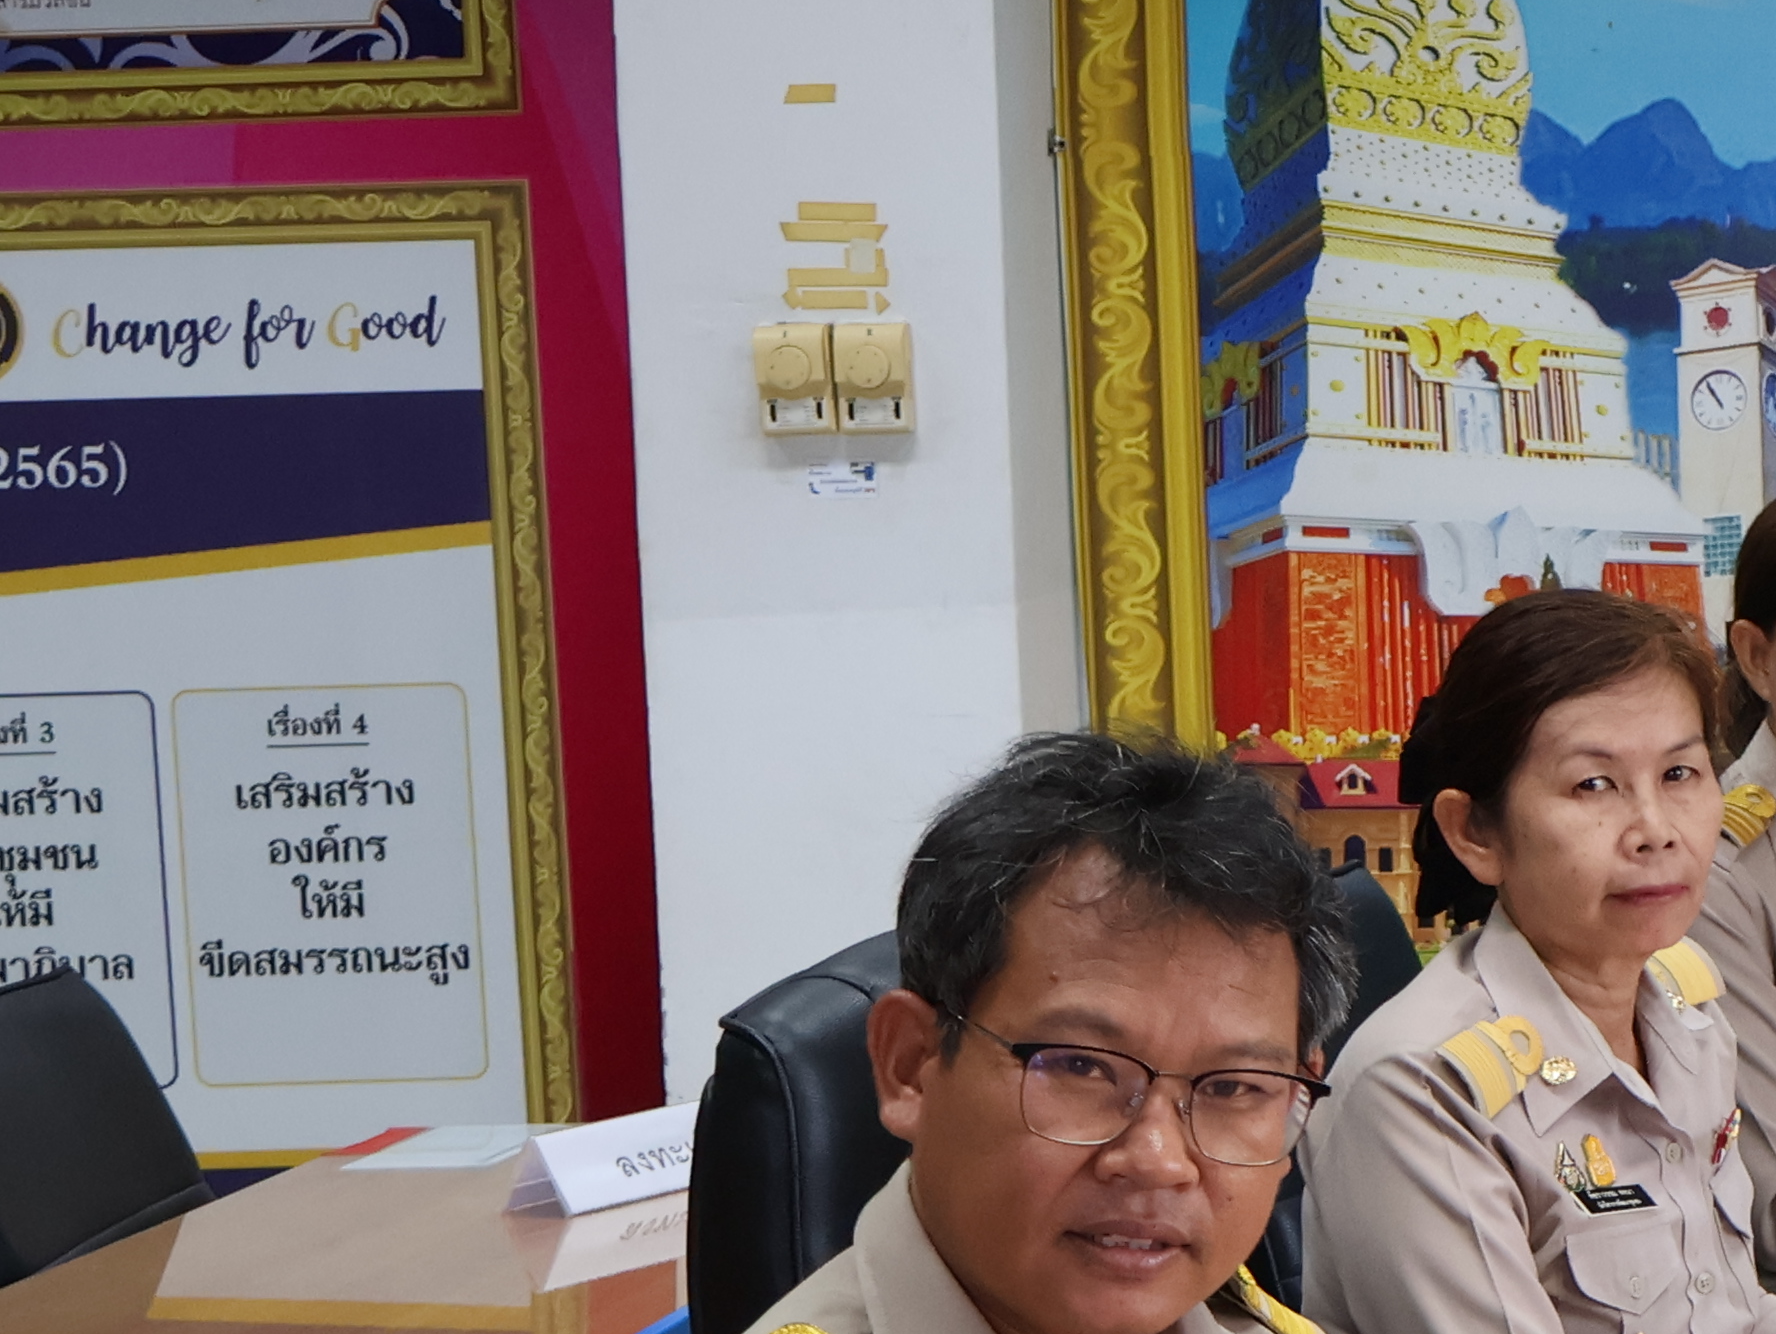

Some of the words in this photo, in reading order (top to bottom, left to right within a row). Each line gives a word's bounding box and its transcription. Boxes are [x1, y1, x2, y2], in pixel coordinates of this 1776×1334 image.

[52, 302, 232, 368] Change
[243, 298, 315, 370] for
[327, 294, 446, 353] Good
[39, 720, 56, 745] 3
[266, 703, 341, 739] เรื่องที่
[351, 714, 369, 736] 4
[235, 767, 416, 810] เสริมสร้าง
[0, 843, 99, 888] ชุมชน
[268, 824, 388, 866] องค์กร
[0, 887, 54, 928] ห้มี
[291, 874, 366, 920] ให้มี
[199, 939, 471, 986] ขีดสมรรถนะสูง
